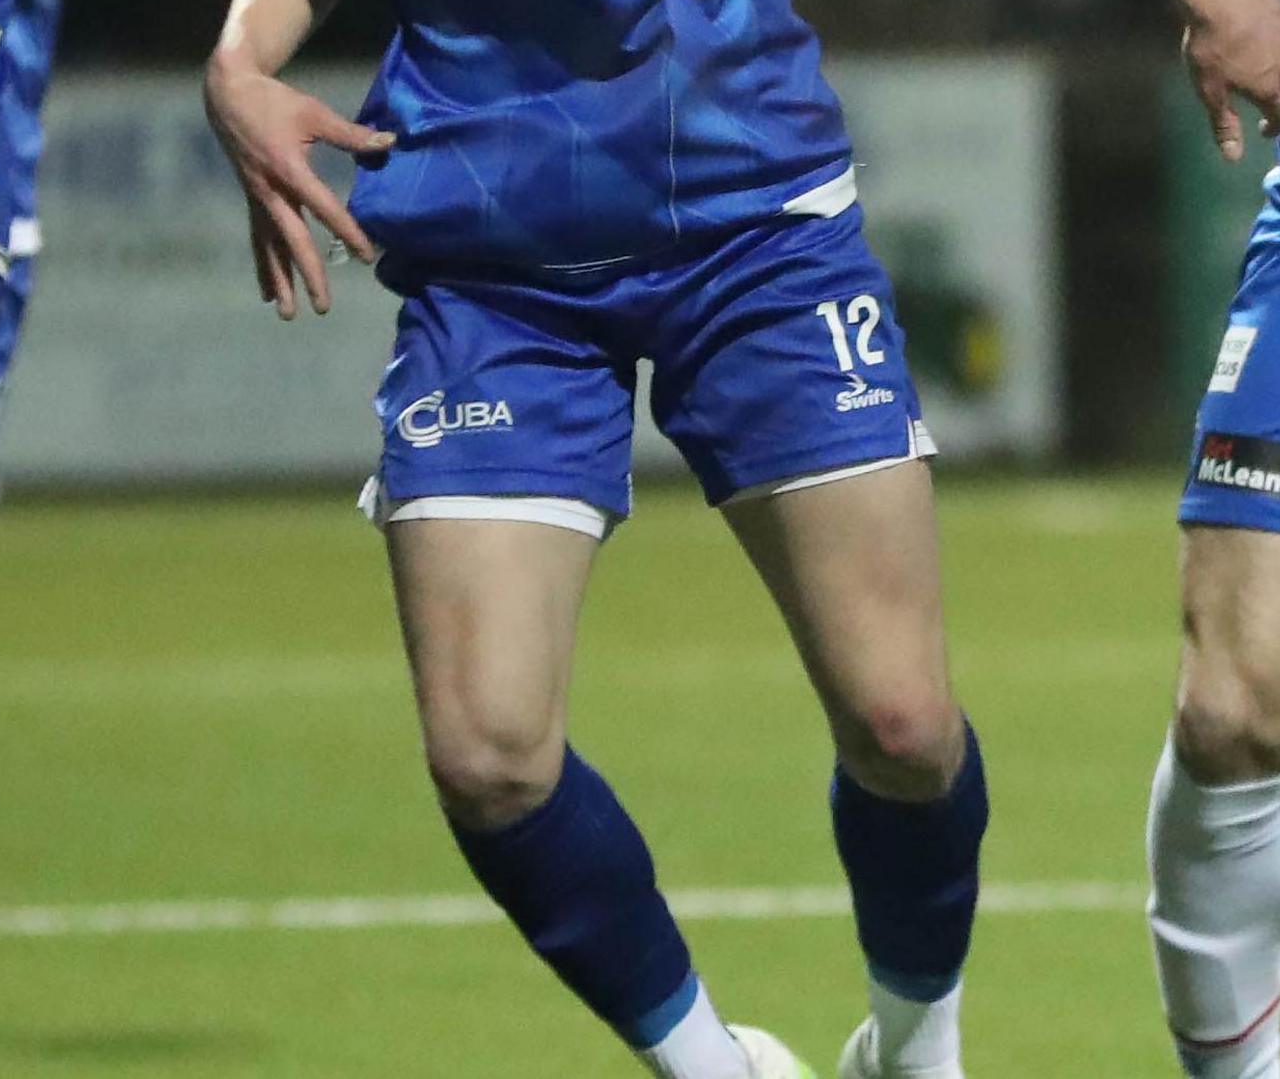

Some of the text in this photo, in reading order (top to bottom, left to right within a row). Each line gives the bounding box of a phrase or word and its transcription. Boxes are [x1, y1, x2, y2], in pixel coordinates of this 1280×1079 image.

[816, 294, 884, 372] 12
[397, 389, 514, 448] CUBA
[836, 387, 895, 412] Swifts
